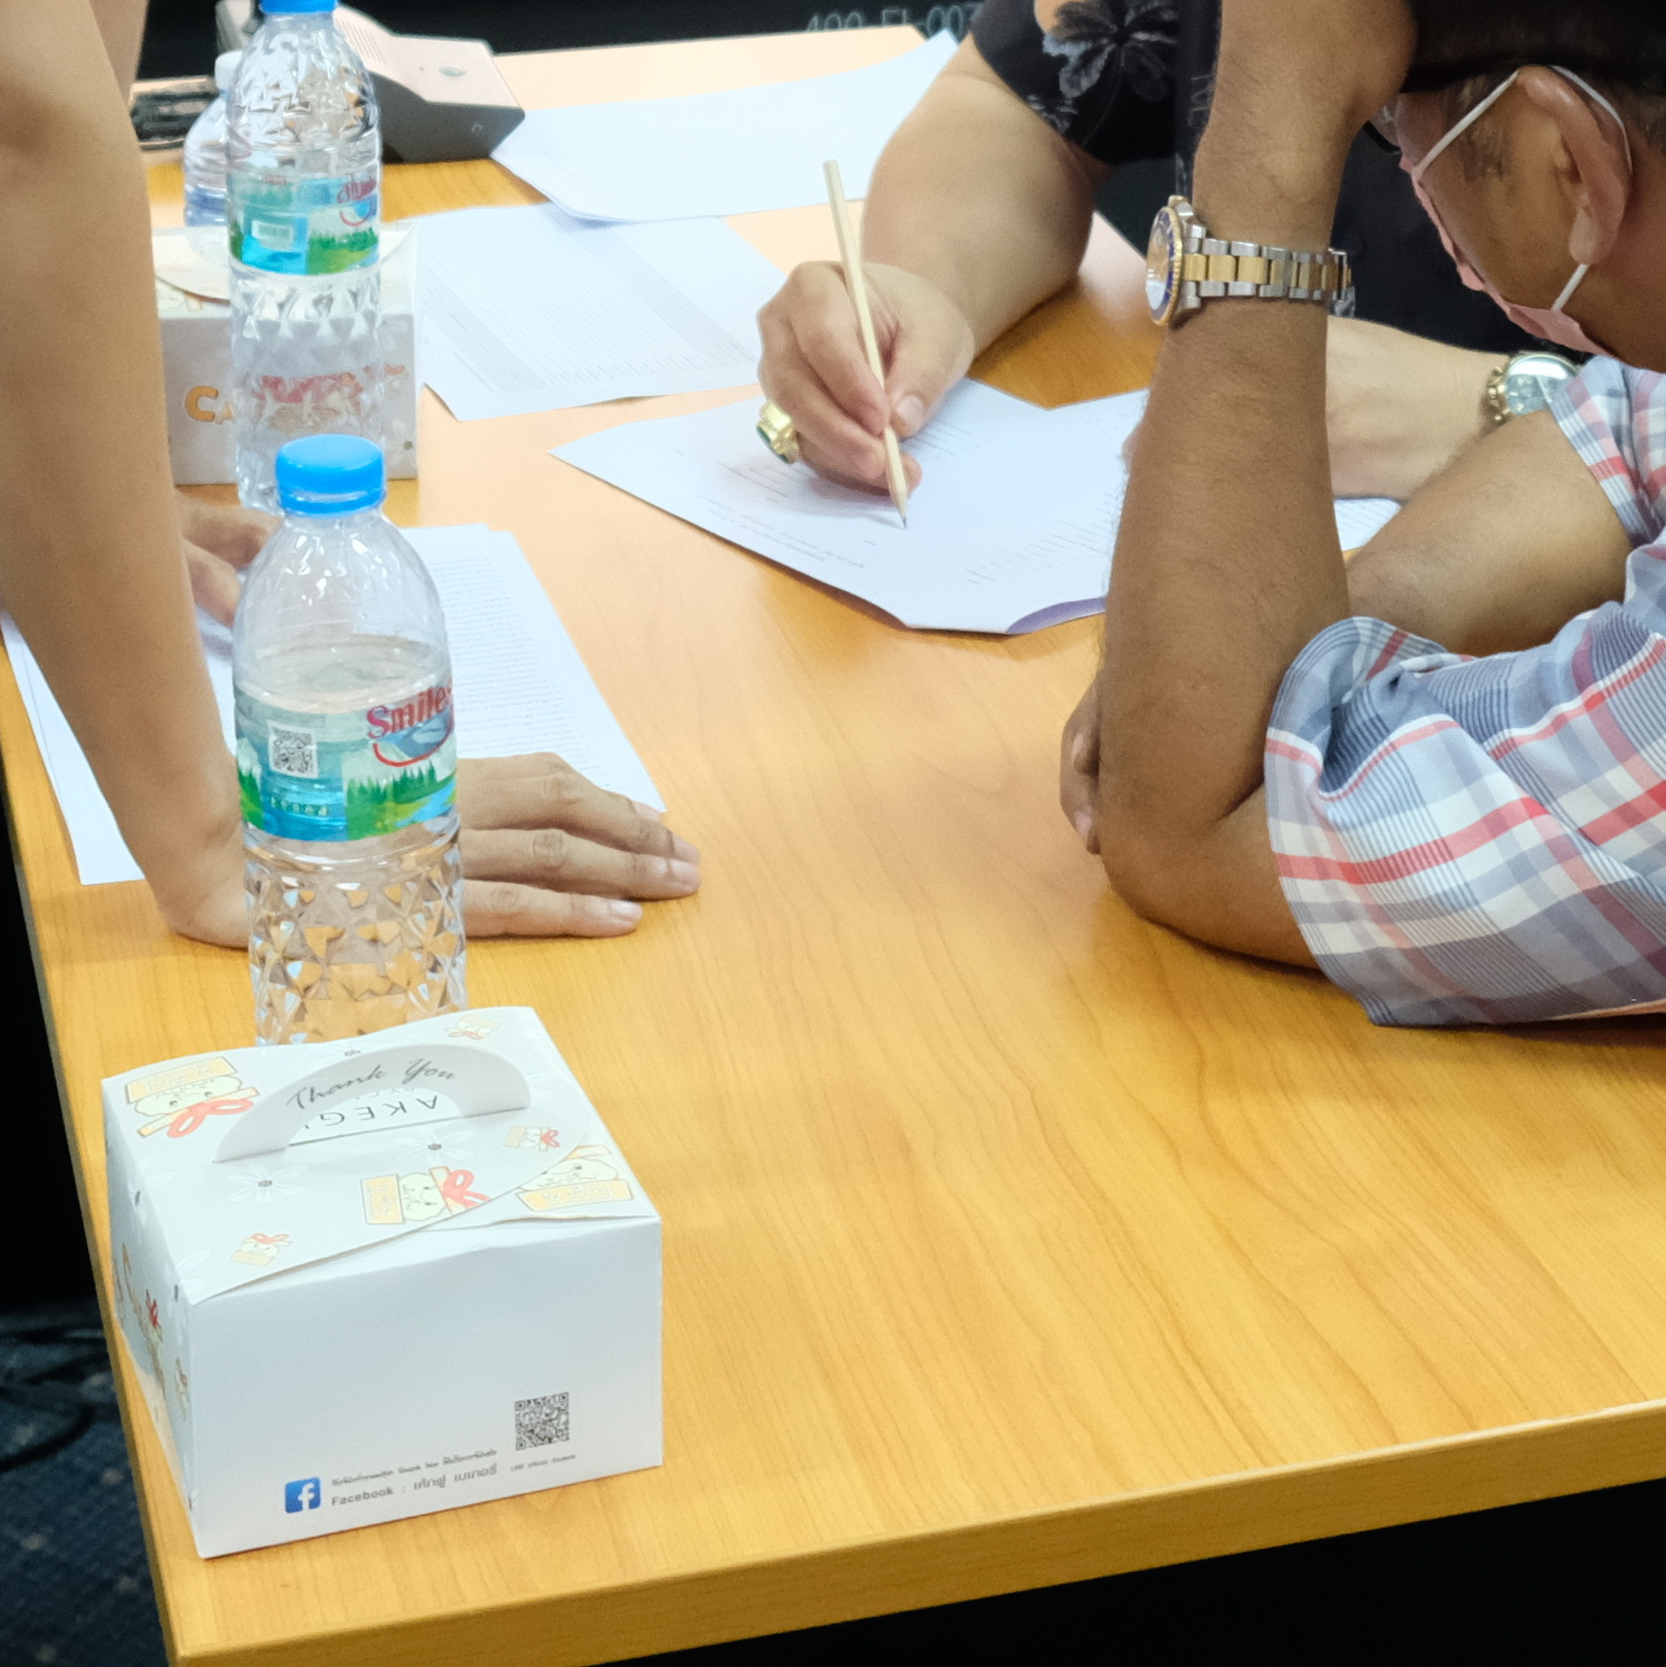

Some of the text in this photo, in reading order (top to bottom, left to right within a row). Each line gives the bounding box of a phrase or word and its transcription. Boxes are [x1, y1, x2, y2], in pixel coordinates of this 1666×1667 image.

[286, 1058, 457, 1109] Thank You
[303, 1095, 438, 1129] AKEG
[331, 1486, 394, 1506] Facebook
